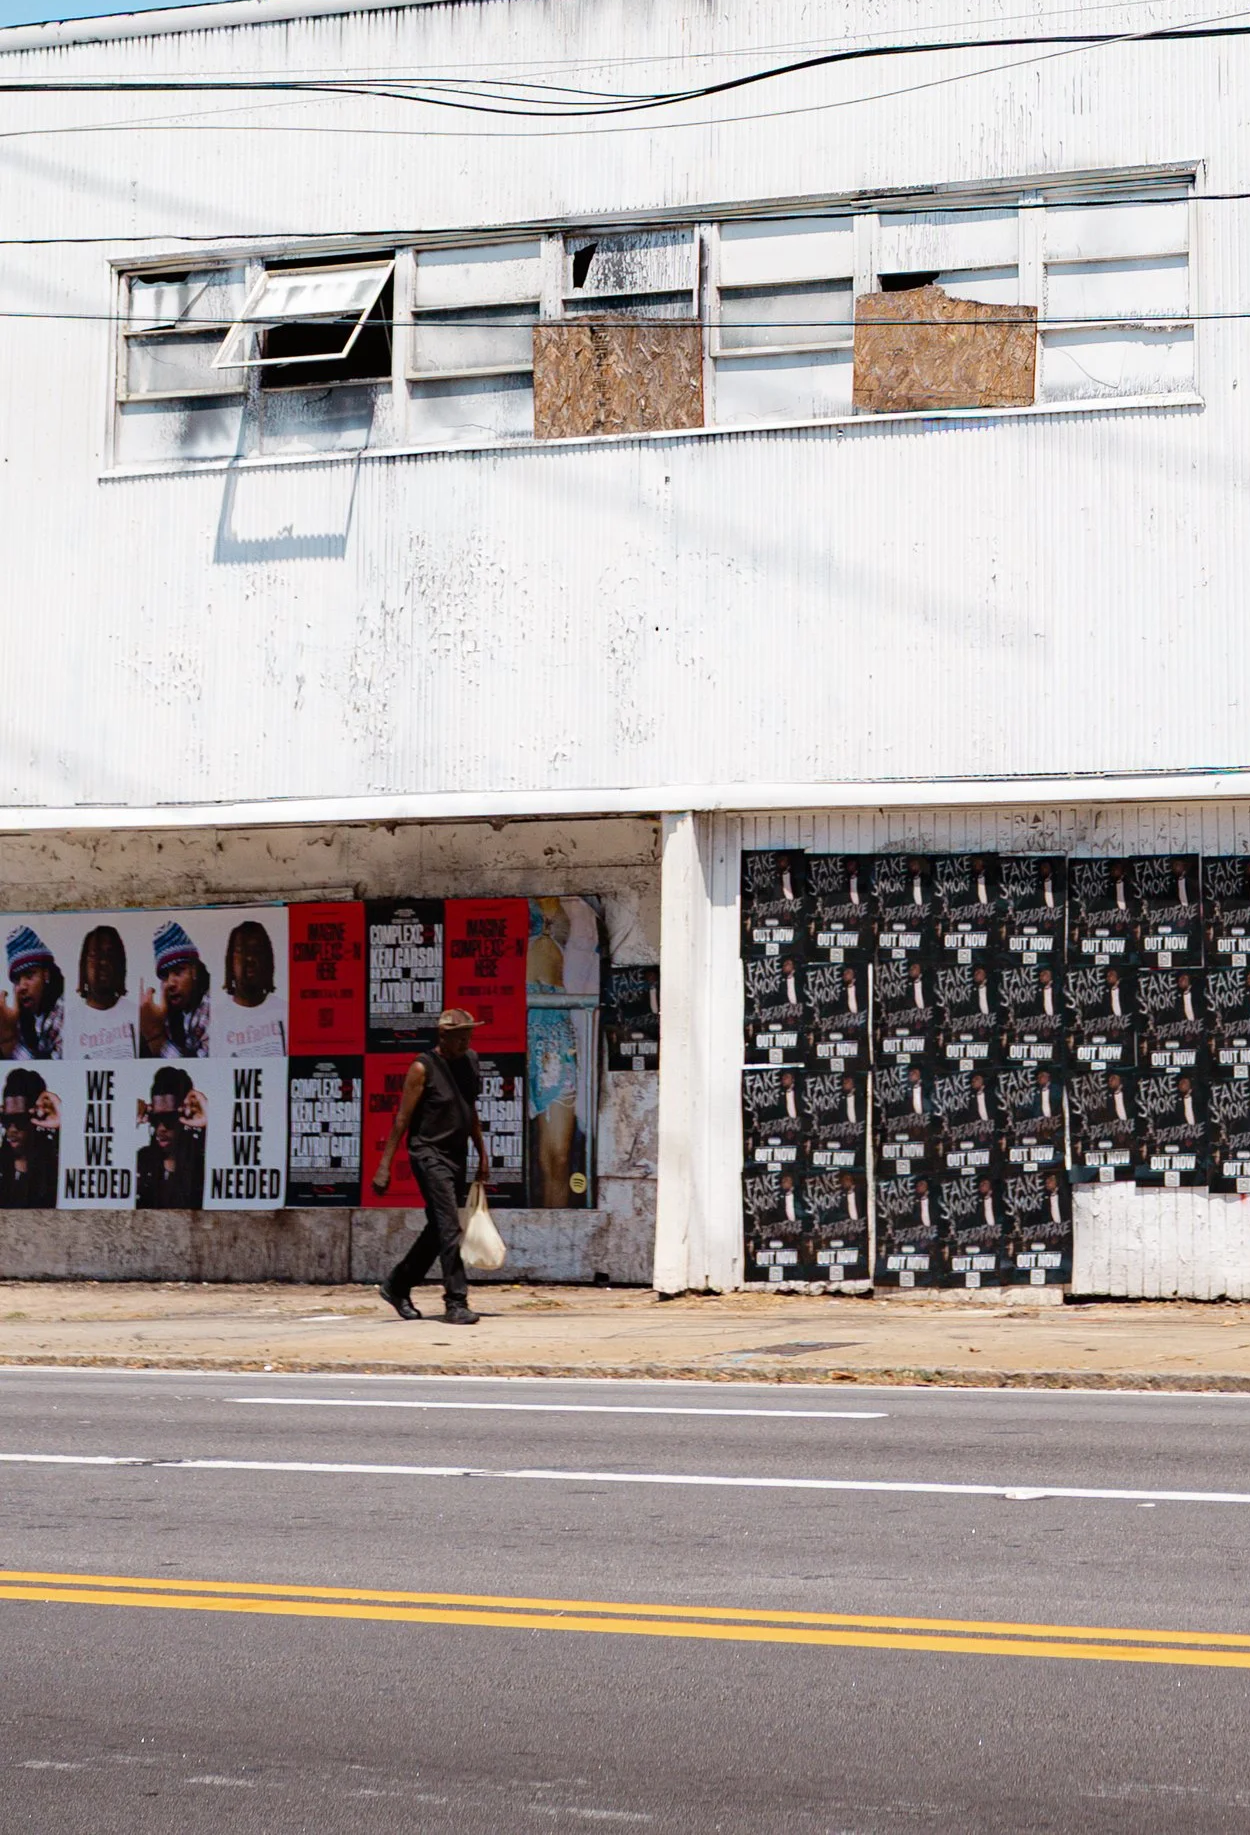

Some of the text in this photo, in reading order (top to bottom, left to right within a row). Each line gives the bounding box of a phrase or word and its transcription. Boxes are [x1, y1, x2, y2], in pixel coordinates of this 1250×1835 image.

[746, 853, 776, 875] FAKE
[809, 855, 845, 880] FAKE
[874, 855, 908, 880] FAKE
[936, 855, 972, 880] FAKE
[1001, 858, 1039, 881] FAKE
[1072, 859, 1110, 884] FAKE
[1133, 856, 1171, 880] FAKE
[1206, 858, 1244, 882] FAKE
[307, 923, 346, 941] IMAGINE
[466, 919, 507, 938] IMAGINE
[753, 928, 794, 942] OUT NOW
[818, 933, 859, 947] OUT NOW
[879, 934, 921, 947] OUT NOW
[945, 934, 987, 947] OUT NOW
[1009, 936, 1053, 951] OUT NOW
[1081, 938, 1125, 953] OUT NOW
[1144, 936, 1188, 950] OUT NOW
[1217, 939, 1236, 953] OUT
[370, 947, 442, 967] KEN CARSON
[747, 956, 783, 981] FAKE
[807, 964, 843, 989] FAKE
[876, 958, 908, 983] FAKE
[936, 964, 973, 988] FAKE
[1002, 964, 1038, 989] FAKE
[1066, 967, 1106, 992] FAKE
[1206, 970, 1245, 994] FAKE
[370, 982, 411, 1002] PLAYBOI
[413, 982, 442, 1002] CARTI
[1138, 972, 1178, 996] FAKE
[757, 1033, 797, 1047] OUT NOW
[817, 1042, 858, 1057] OUT NOW
[883, 1038, 925, 1052] OUT NOW
[946, 1044, 988, 1058] OUT NOW
[1010, 1044, 1053, 1058] OUT NOW
[1077, 1046, 1122, 1060] OUT NOW
[1151, 1051, 1196, 1065] OUT NOW
[1220, 1050, 1238, 1064] OUT
[87, 1070, 115, 1101] WE
[234, 1069, 262, 1099] WE
[744, 1070, 781, 1094] FAKE
[804, 1075, 843, 1098] FAKE
[875, 1065, 909, 1088] FAKE
[935, 1073, 973, 1096] FAKE
[998, 1068, 1036, 1092] FAKE
[1072, 1072, 1106, 1096] FAKE
[1139, 1075, 1178, 1098] FAKE
[1211, 1080, 1250, 1105] FAKE
[85, 1104, 114, 1133] ALL
[233, 1102, 262, 1132] ALL
[291, 1102, 313, 1122] KEN
[315, 1102, 361, 1122] CARSON
[85, 1136, 113, 1166] WE
[233, 1135, 261, 1166] WE
[755, 1147, 796, 1161] OUT NOW
[813, 1151, 856, 1166] OUT NOW
[882, 1144, 924, 1157] OUT NOW
[947, 1151, 990, 1167] OUT NOW
[1010, 1147, 1054, 1161] OUT NOW
[1086, 1151, 1130, 1166] OUT NOW
[1150, 1155, 1195, 1169] OUT NOW
[1223, 1163, 1242, 1176] OUT
[66, 1169, 131, 1199] NEEDED
[212, 1169, 281, 1199] NEEDED
[745, 1174, 781, 1197] FAKE
[804, 1173, 841, 1198] FAKE
[879, 1176, 916, 1199] FAKE
[941, 1177, 977, 1200] FAKE
[1005, 1173, 1044, 1198] FAKE
[756, 1250, 798, 1264] OUT NOW
[817, 1250, 858, 1264] OUT NOW
[887, 1256, 929, 1269] OUT NOW
[952, 1256, 995, 1270] OUT NOW
[1016, 1253, 1062, 1268] OUT NOW
